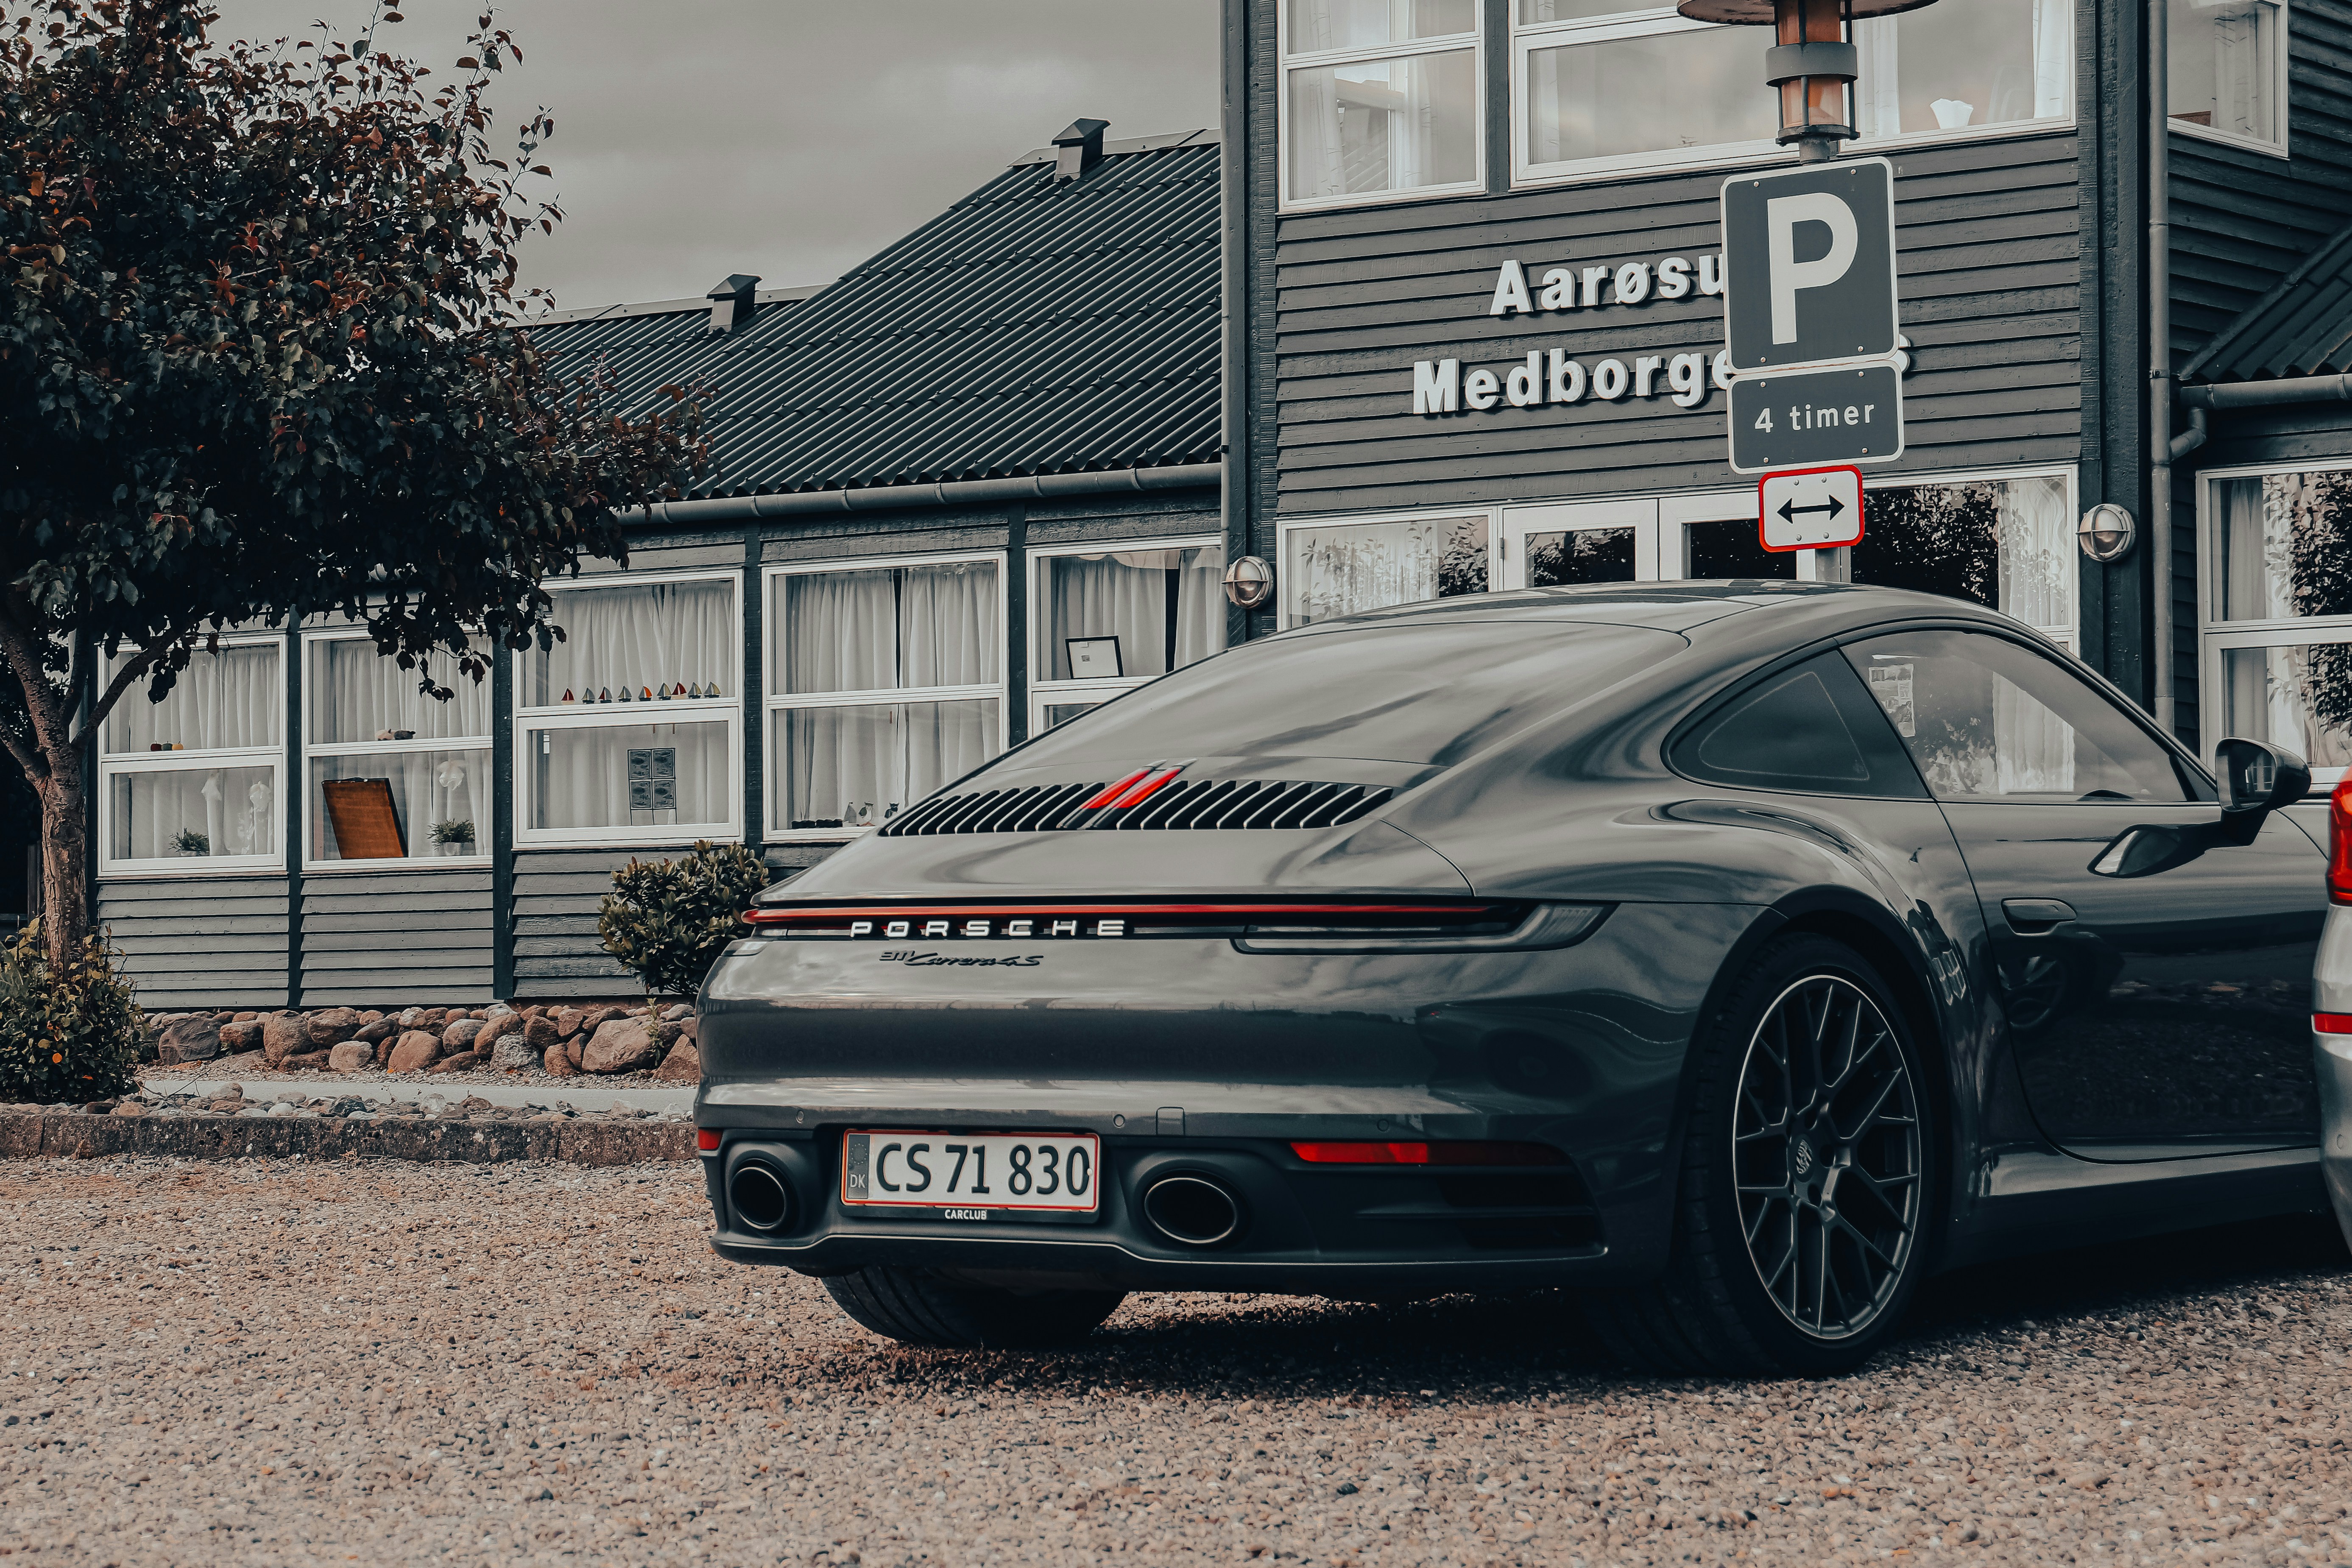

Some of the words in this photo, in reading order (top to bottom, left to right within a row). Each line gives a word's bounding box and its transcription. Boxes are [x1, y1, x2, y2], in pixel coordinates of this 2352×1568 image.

[1766, 192, 1860, 345] P
[1489, 254, 1724, 315] Aarøsu
[1754, 407, 1774, 433] 4
[1789, 404, 1875, 431] timer
[850, 919, 1125, 938] PORSCHE
[879, 950, 915, 961] 911
[849, 1173, 866, 1189] DK
[876, 1142, 932, 1193] CS
[945, 1144, 990, 1194] 71
[1008, 1144, 1091, 1196] 830
[944, 1208, 988, 1220] CARCLUB
